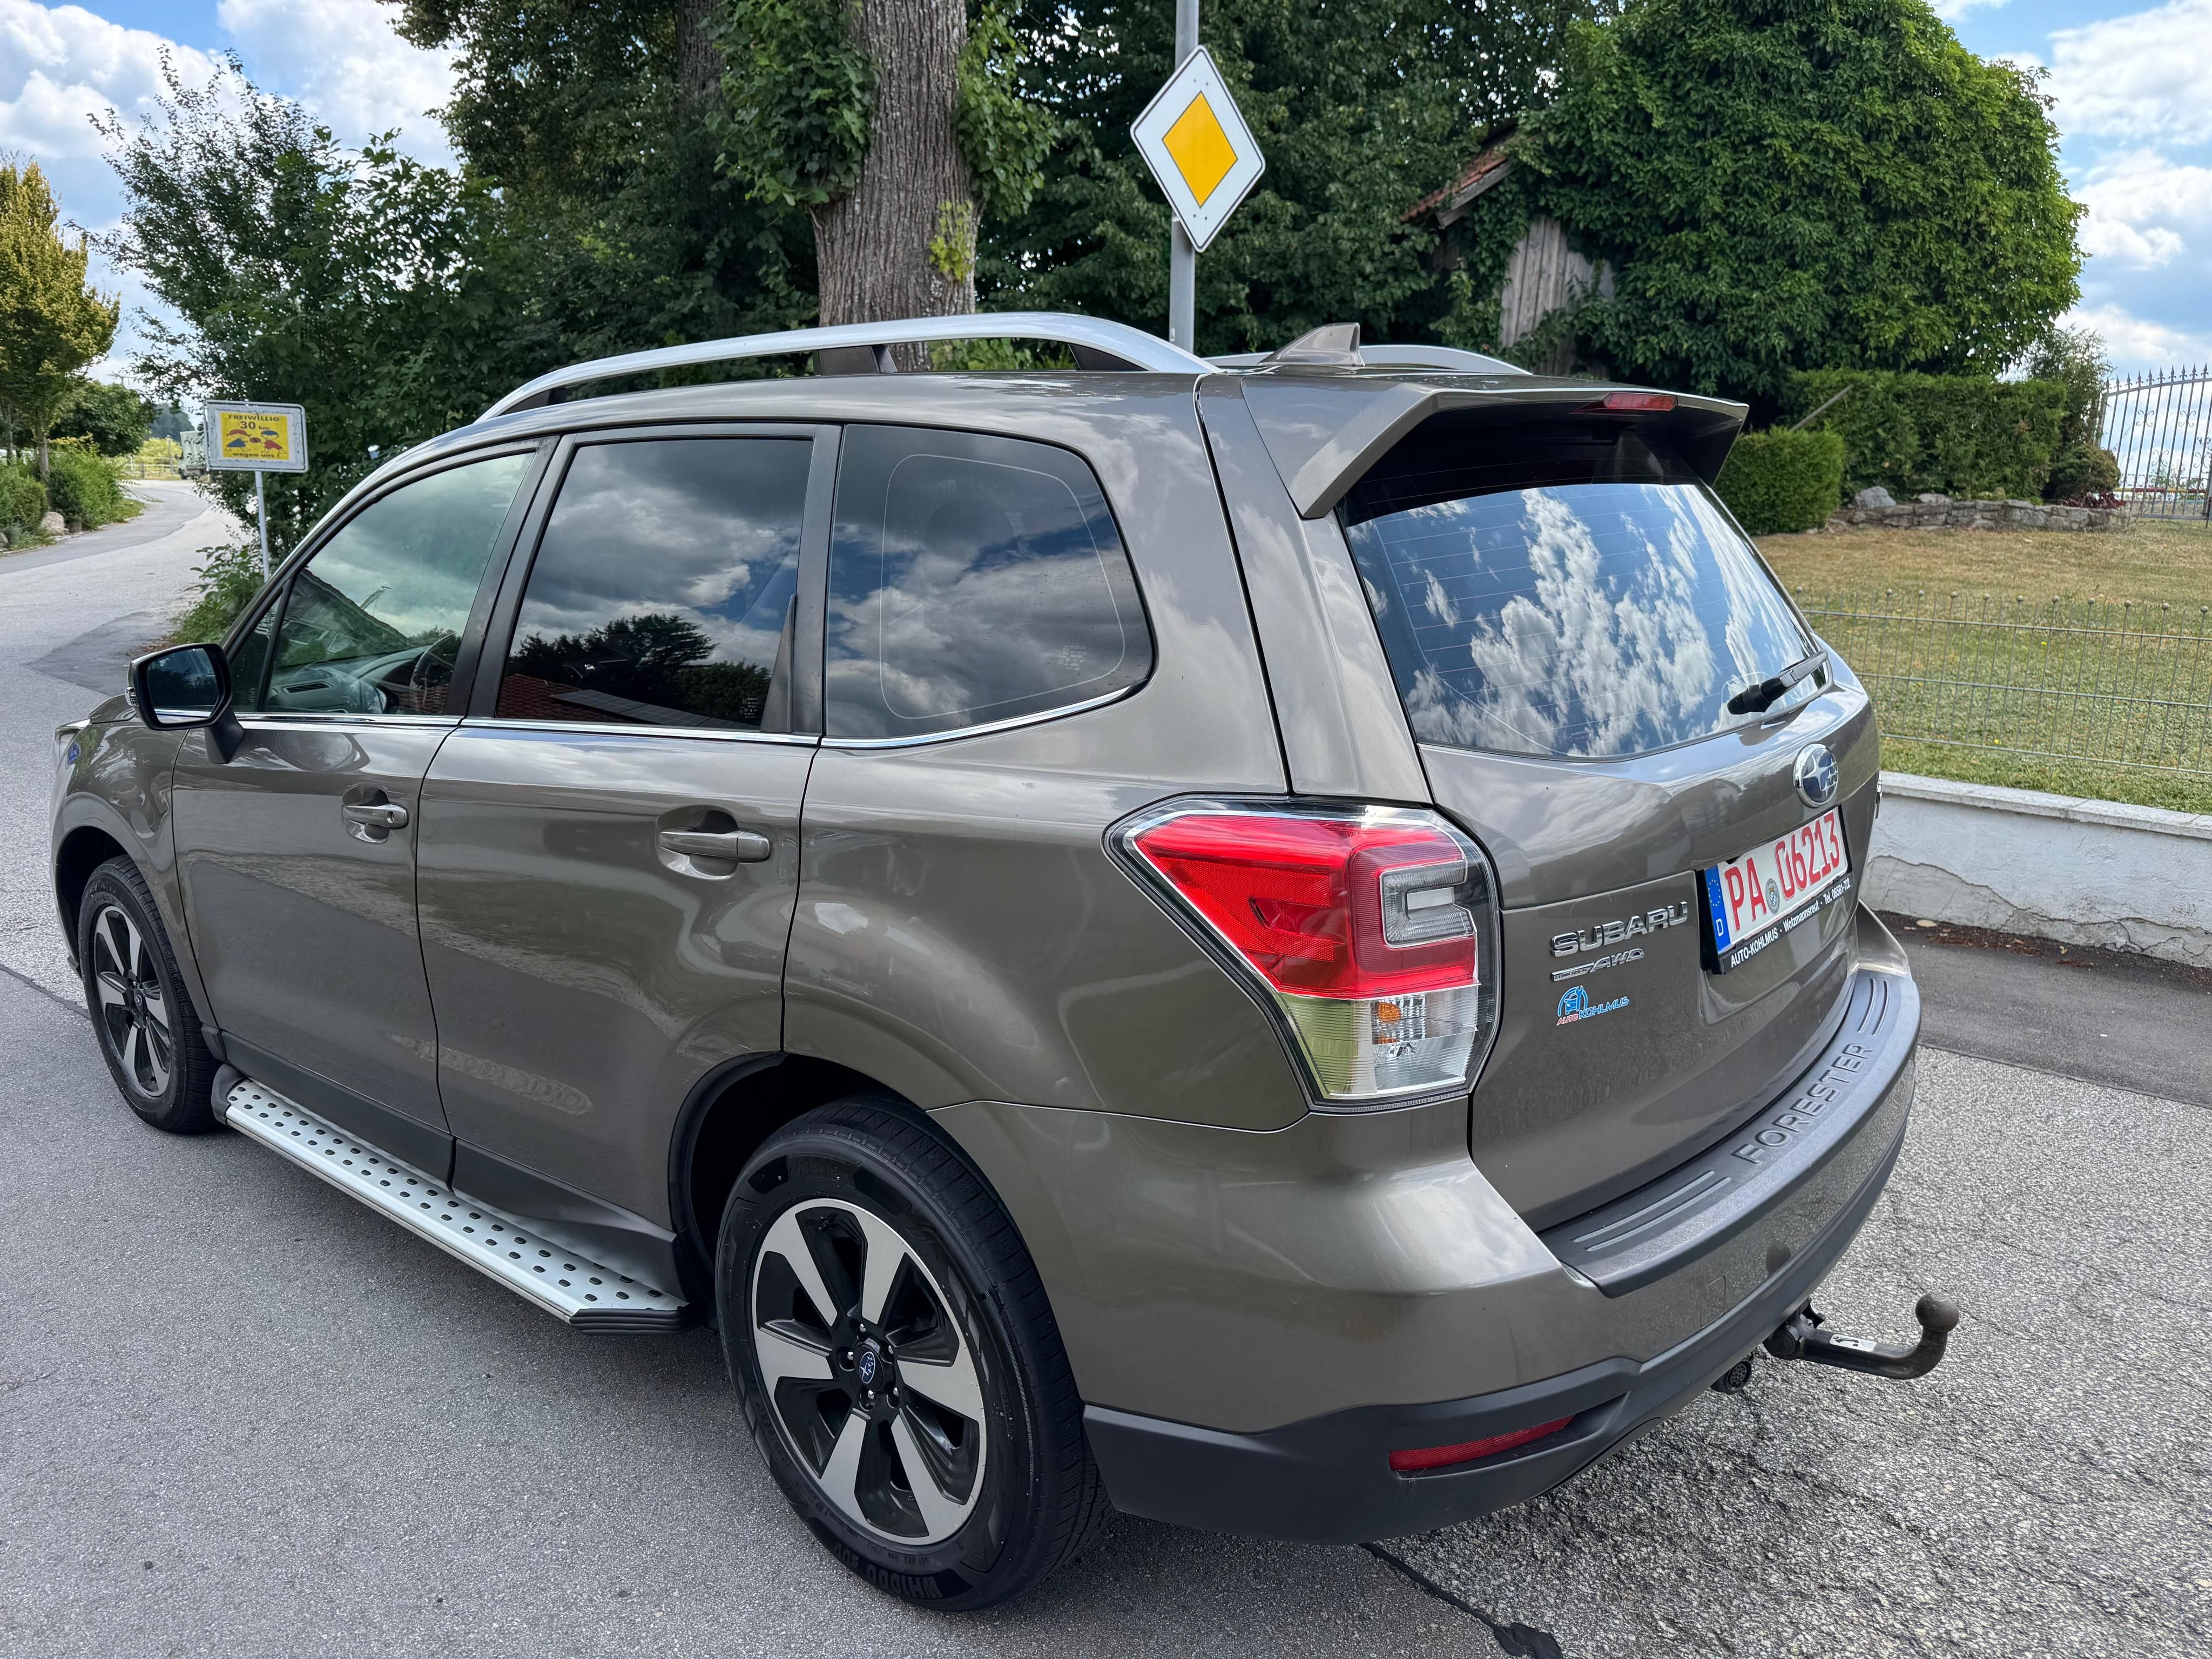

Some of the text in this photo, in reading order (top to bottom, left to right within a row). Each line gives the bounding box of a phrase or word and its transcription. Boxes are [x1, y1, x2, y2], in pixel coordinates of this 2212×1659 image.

[240, 421, 255, 429] 30
[1725, 812, 1840, 932] PA 06213
[1551, 901, 1688, 957] SUBARU
[1715, 918, 1724, 937] D
[1731, 927, 1778, 968] AUTO-KOHLMUS
[1783, 900, 1819, 933] Wotzmannsreut
[1823, 891, 1832, 905] Tel.
[1590, 948, 1644, 973] AWD
[1731, 1043, 1873, 1165] FORESTER
